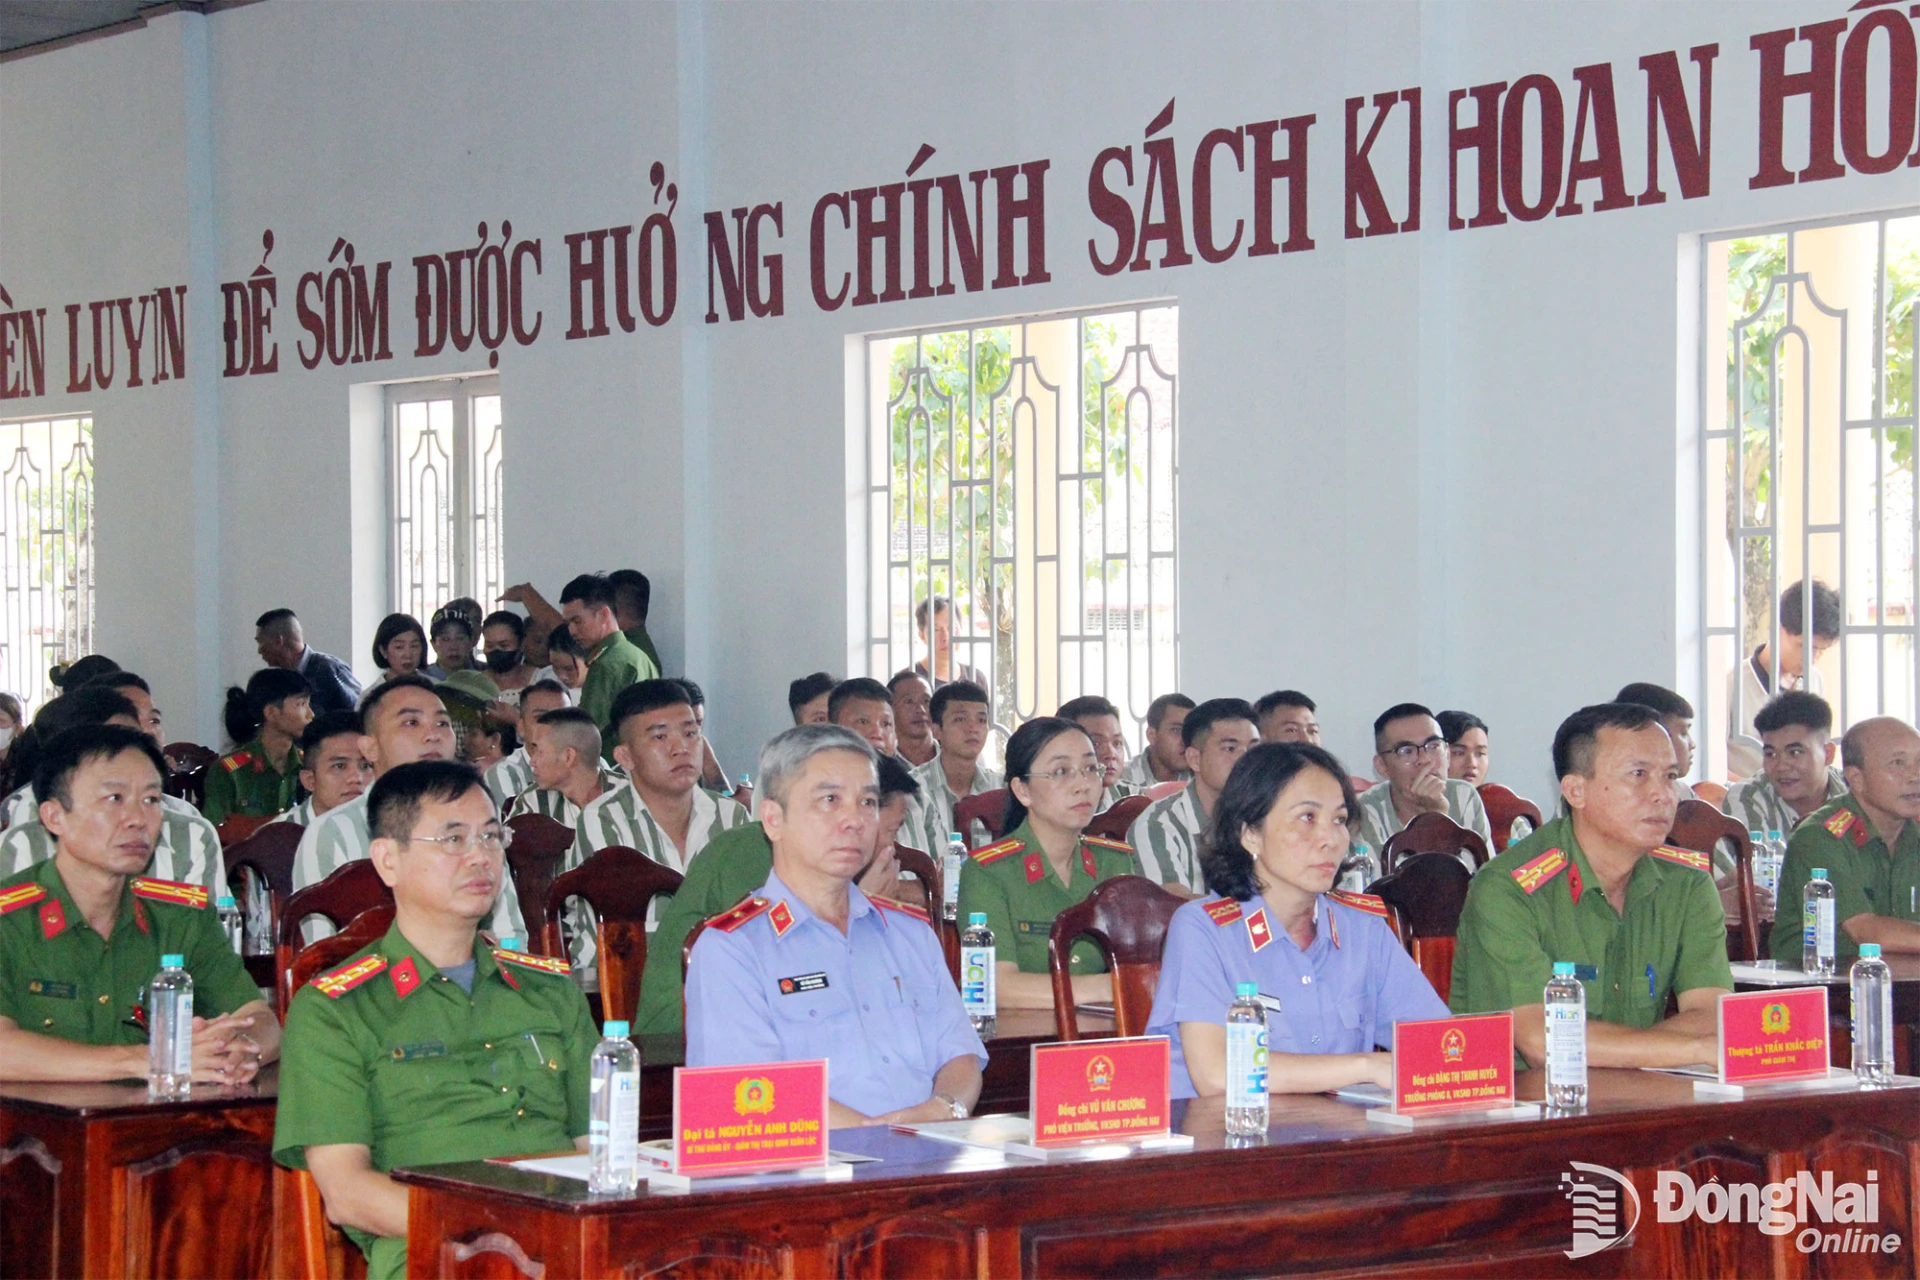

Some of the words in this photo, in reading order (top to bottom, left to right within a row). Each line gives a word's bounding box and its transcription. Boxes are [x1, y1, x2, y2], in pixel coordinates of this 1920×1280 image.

[65, 284, 187, 394] LUYN
[221, 229, 279, 377] ĐỂ
[296, 236, 393, 370] SỚM
[413, 220, 542, 368] ĐƯỢC
[809, 143, 1051, 312] CHÍNH
[1088, 96, 1316, 276] SÁCH
[964, 953, 984, 1003] Hion
[764, 1123, 787, 1135] ANH
